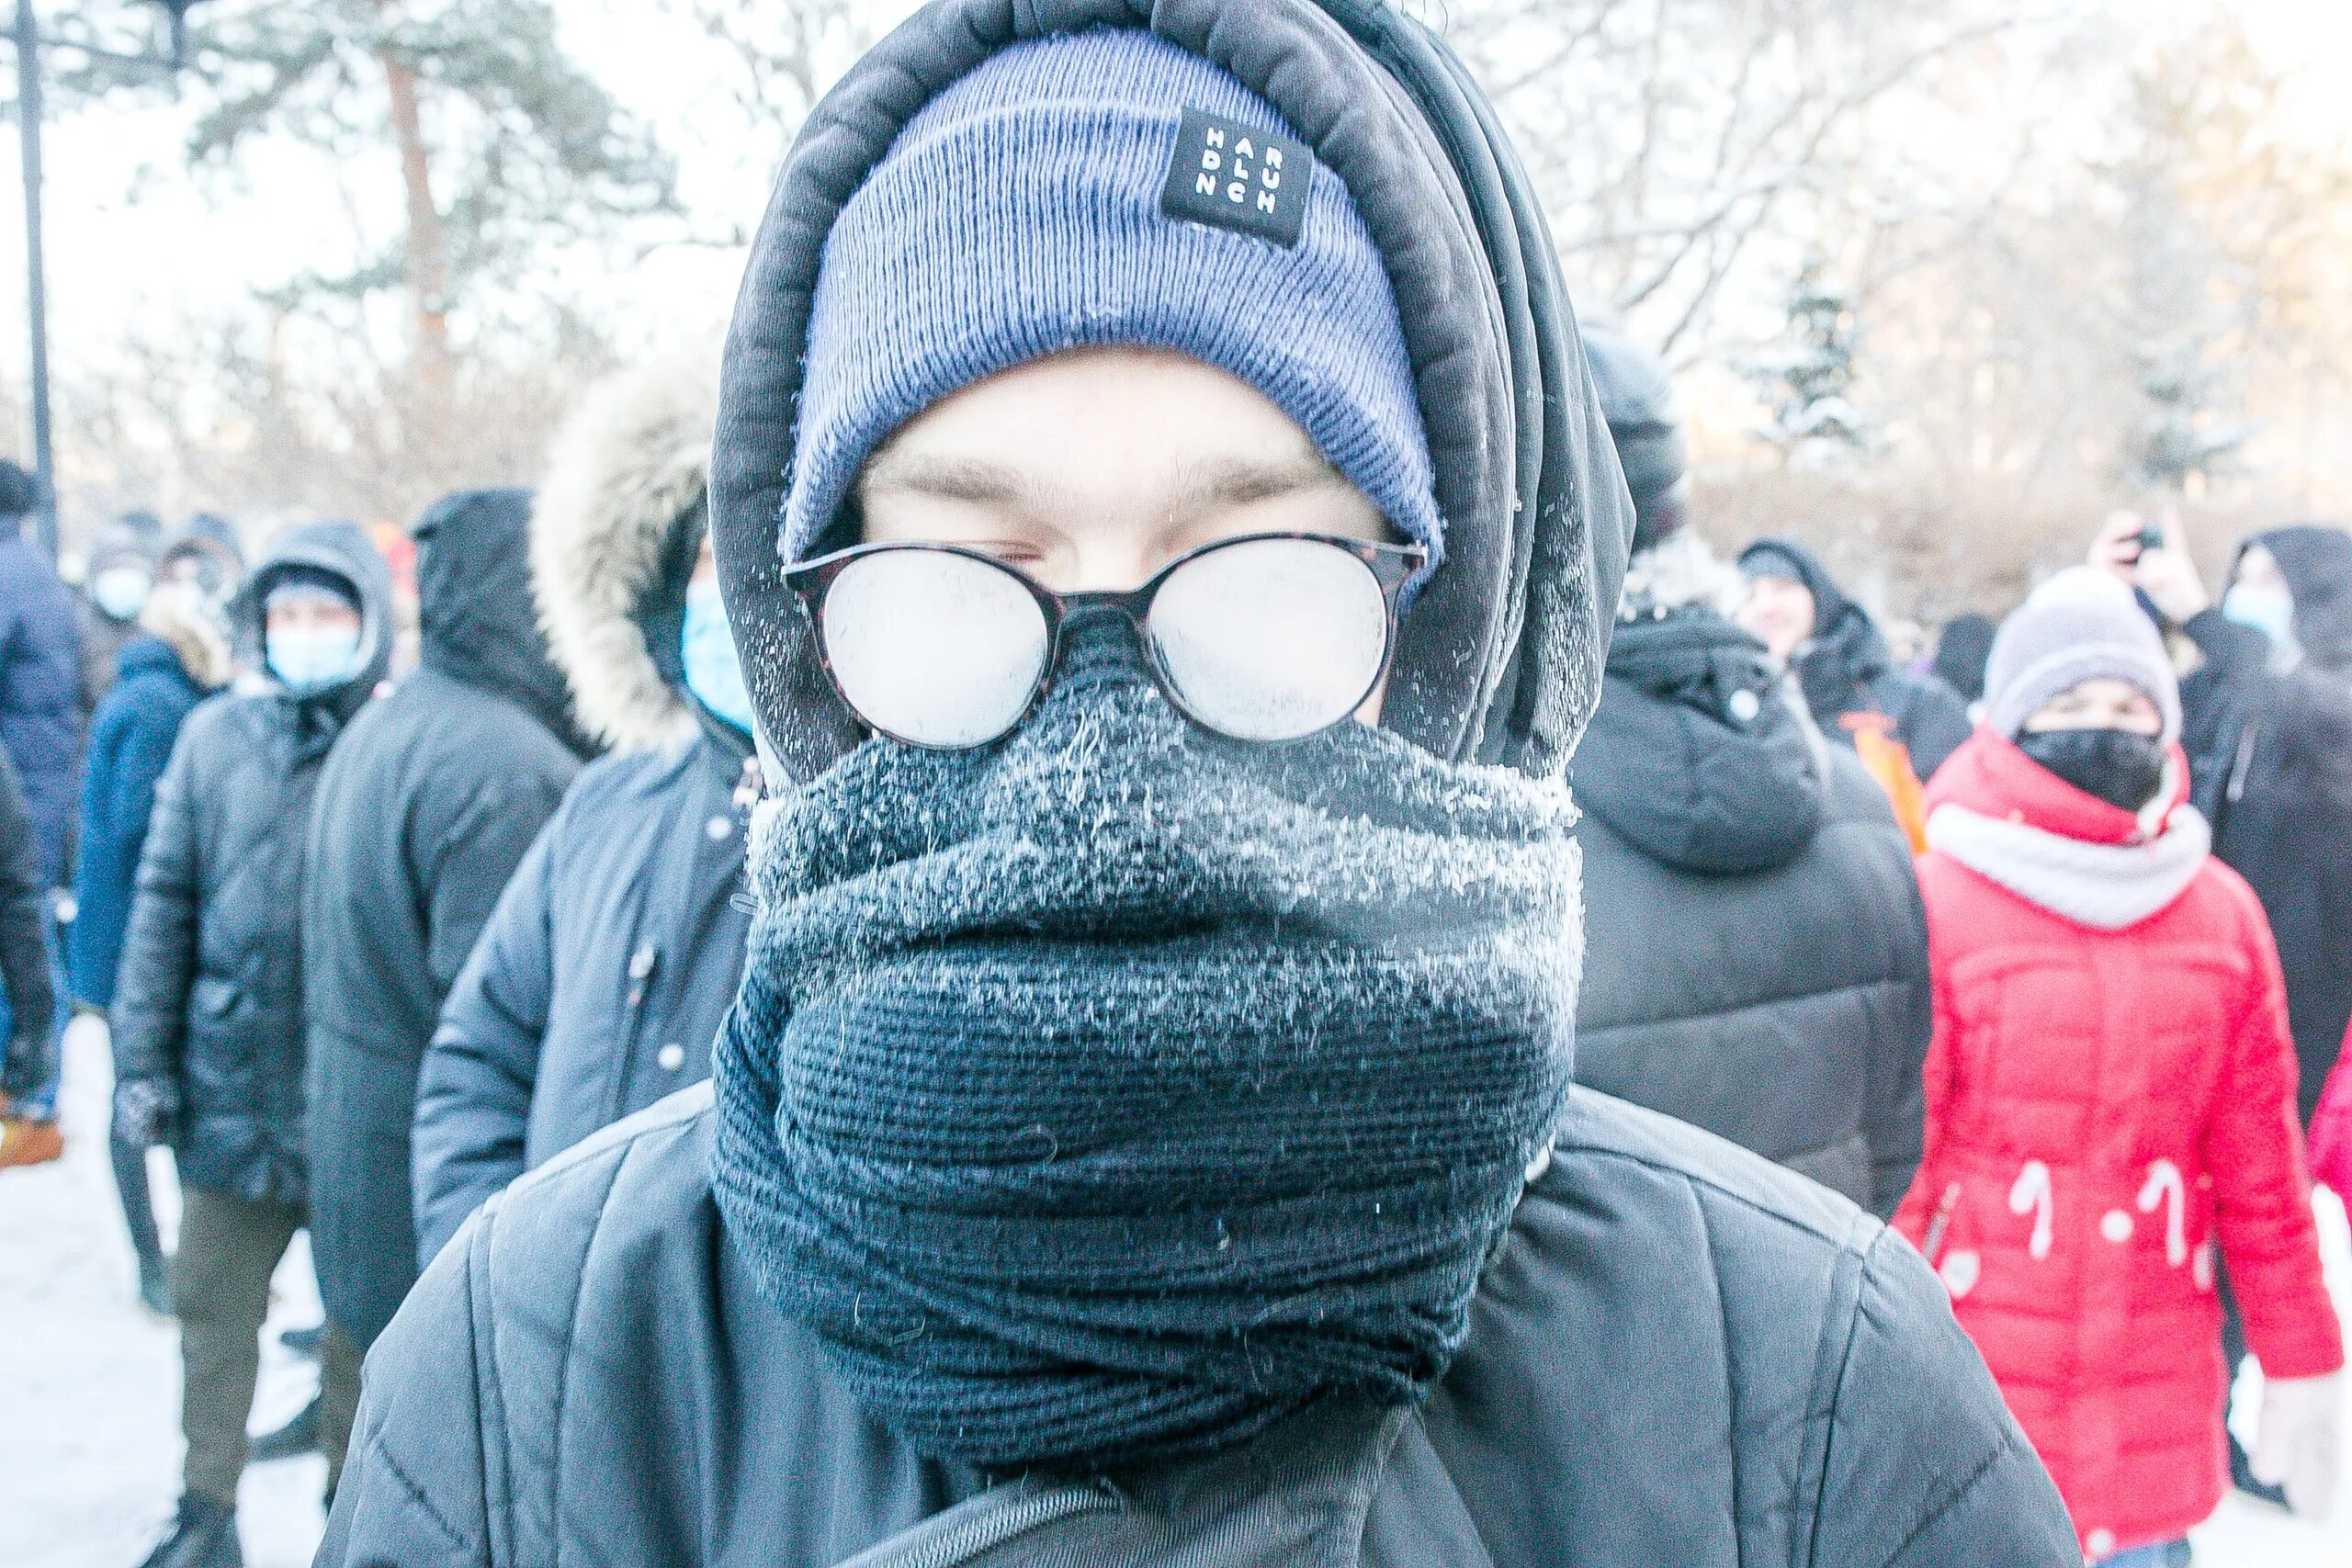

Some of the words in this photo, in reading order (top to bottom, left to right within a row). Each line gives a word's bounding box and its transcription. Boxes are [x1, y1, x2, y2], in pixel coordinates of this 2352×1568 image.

[1202, 149, 1280, 189] DLU
[1206, 127, 1283, 170] HAR
[1195, 172, 1276, 214] NCH
